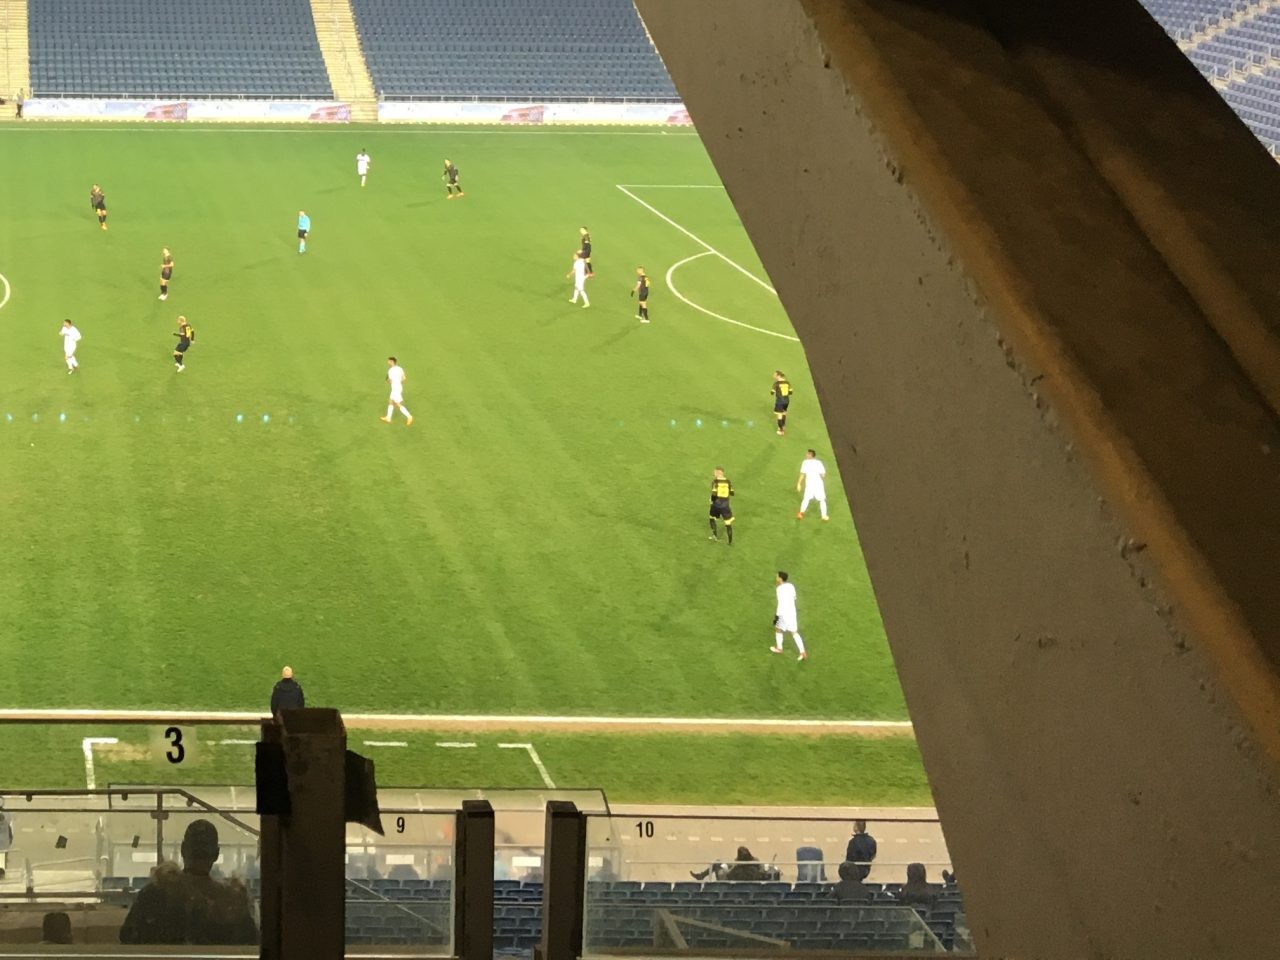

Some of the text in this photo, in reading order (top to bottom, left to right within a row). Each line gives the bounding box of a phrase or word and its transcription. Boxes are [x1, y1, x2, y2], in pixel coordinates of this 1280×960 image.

[164, 726, 186, 765] 3
[396, 816, 406, 834] 9
[635, 820, 654, 839] 10
